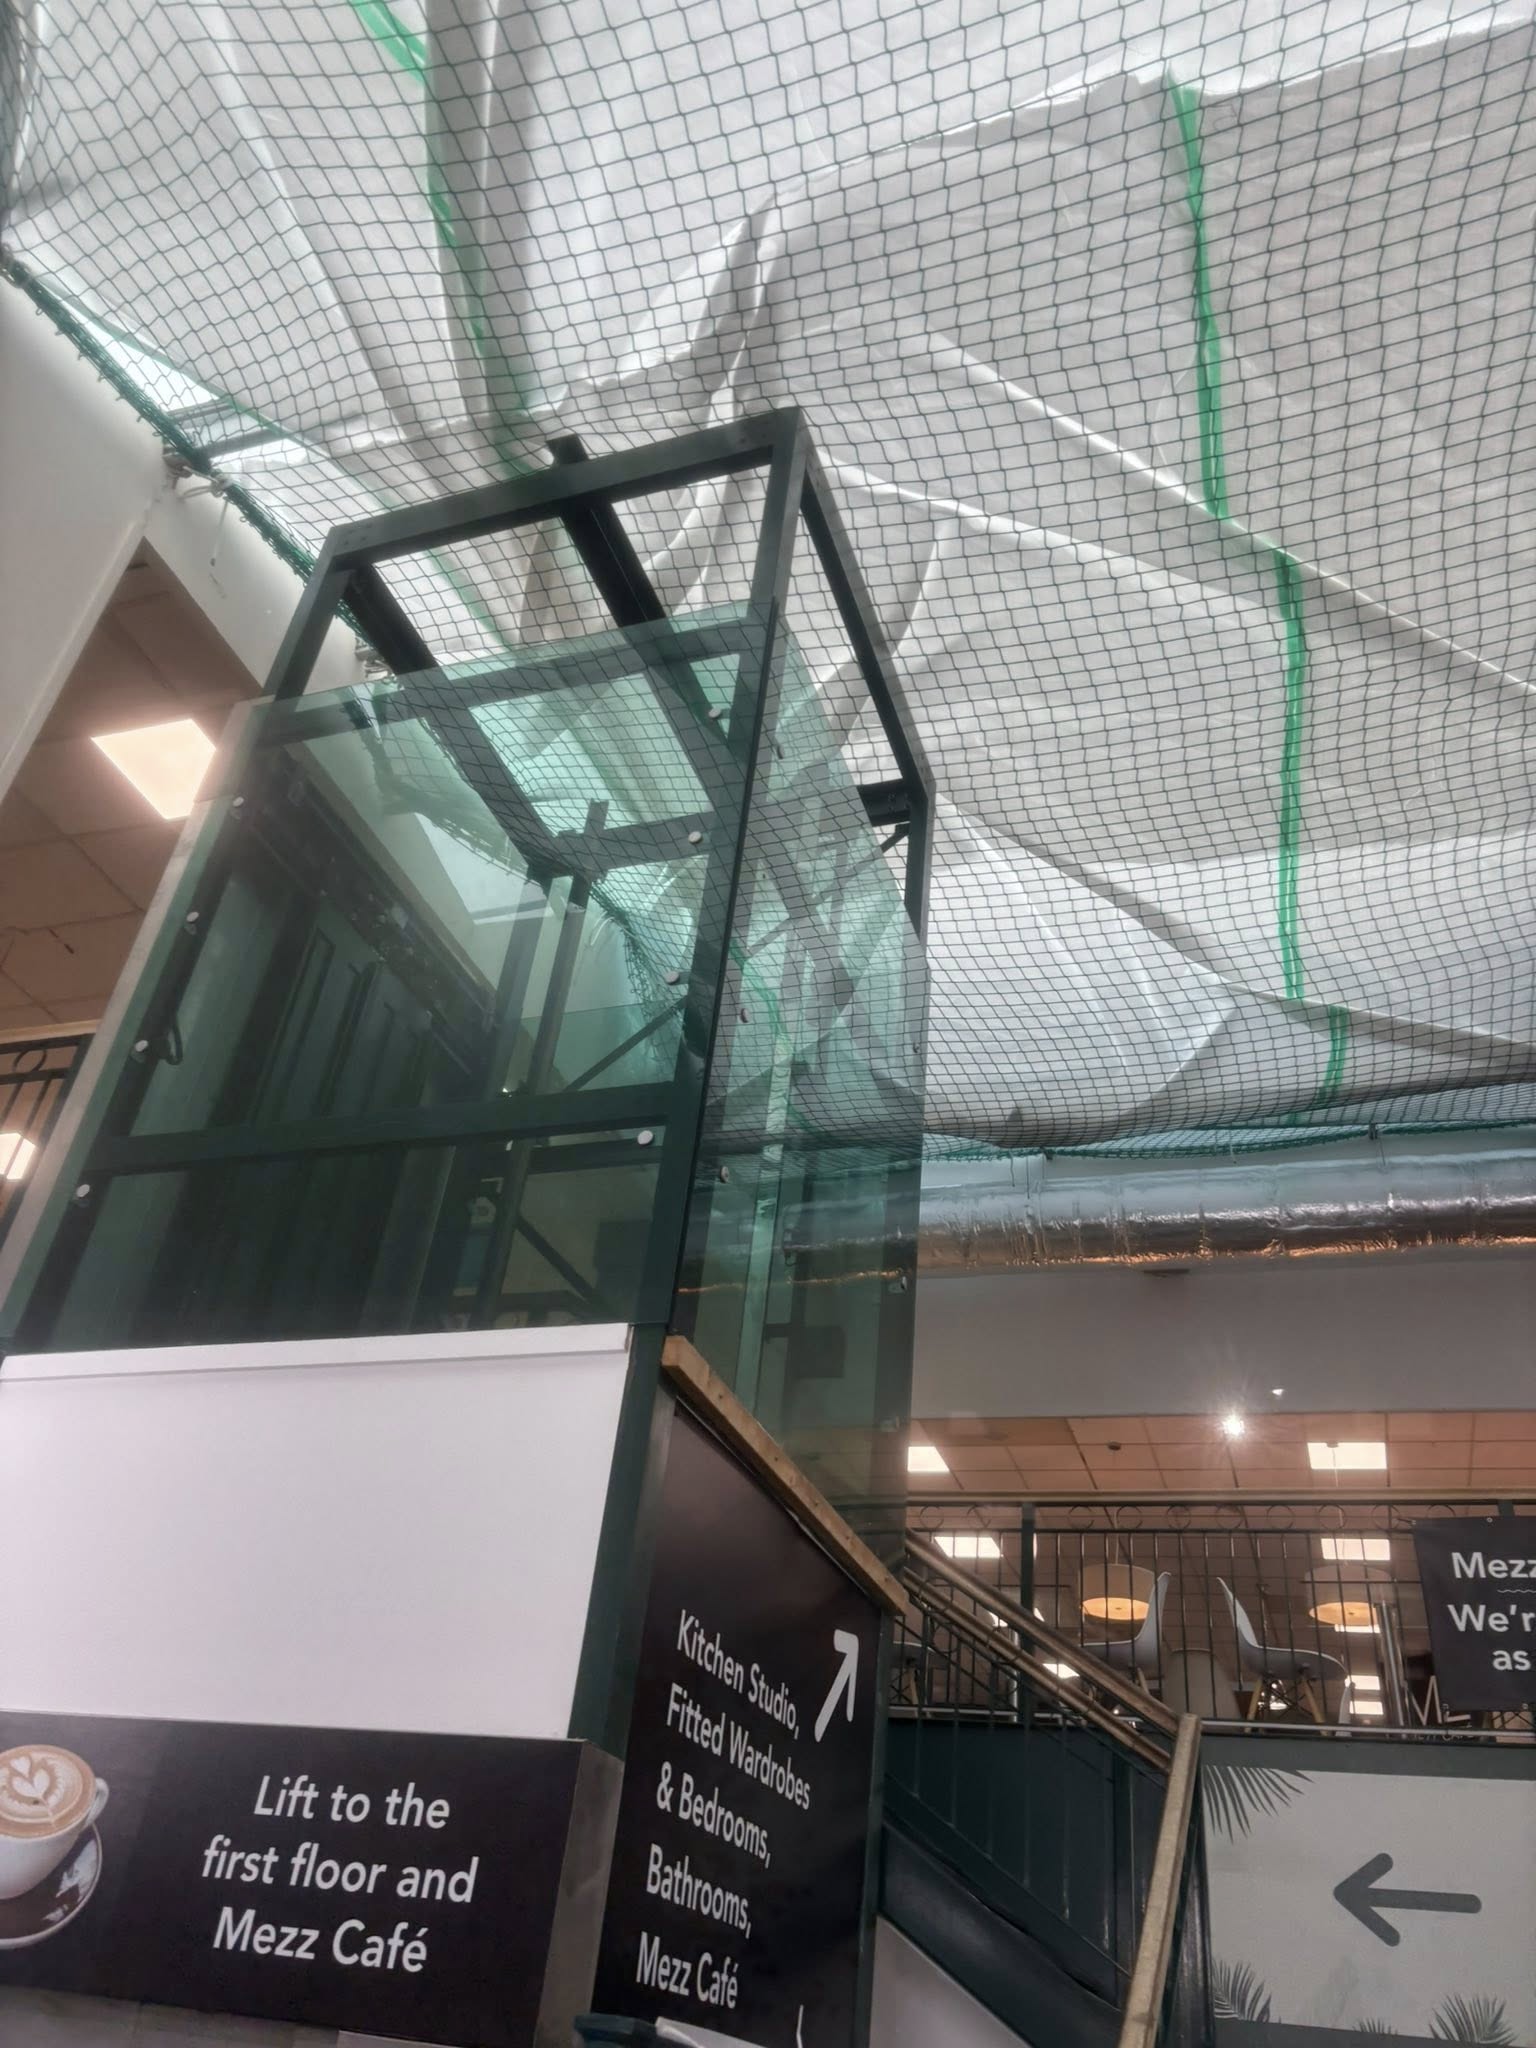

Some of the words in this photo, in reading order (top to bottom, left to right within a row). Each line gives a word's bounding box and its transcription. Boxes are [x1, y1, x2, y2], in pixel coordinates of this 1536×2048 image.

[677, 1609, 743, 1694] Kitchen
[748, 1662, 799, 1740] Studio,
[1492, 1649, 1532, 1671] as
[666, 1682, 726, 1757] Fitted
[729, 1719, 811, 1810] Wardrobes
[254, 1775, 319, 1820] Lift
[331, 1785, 371, 1823] to
[385, 1782, 450, 1829] the
[656, 1761, 674, 1814] &
[678, 1772, 771, 1869] Bedrooms,
[202, 1834, 279, 1885] first
[290, 1842, 387, 1894] floor
[396, 1856, 479, 1903] and
[646, 1843, 752, 1940] Bathrooms,
[213, 1906, 319, 1960] Mezz
[332, 1919, 428, 1973] Café
[636, 1931, 691, 1997] Mezz
[696, 1952, 739, 2010] Café
